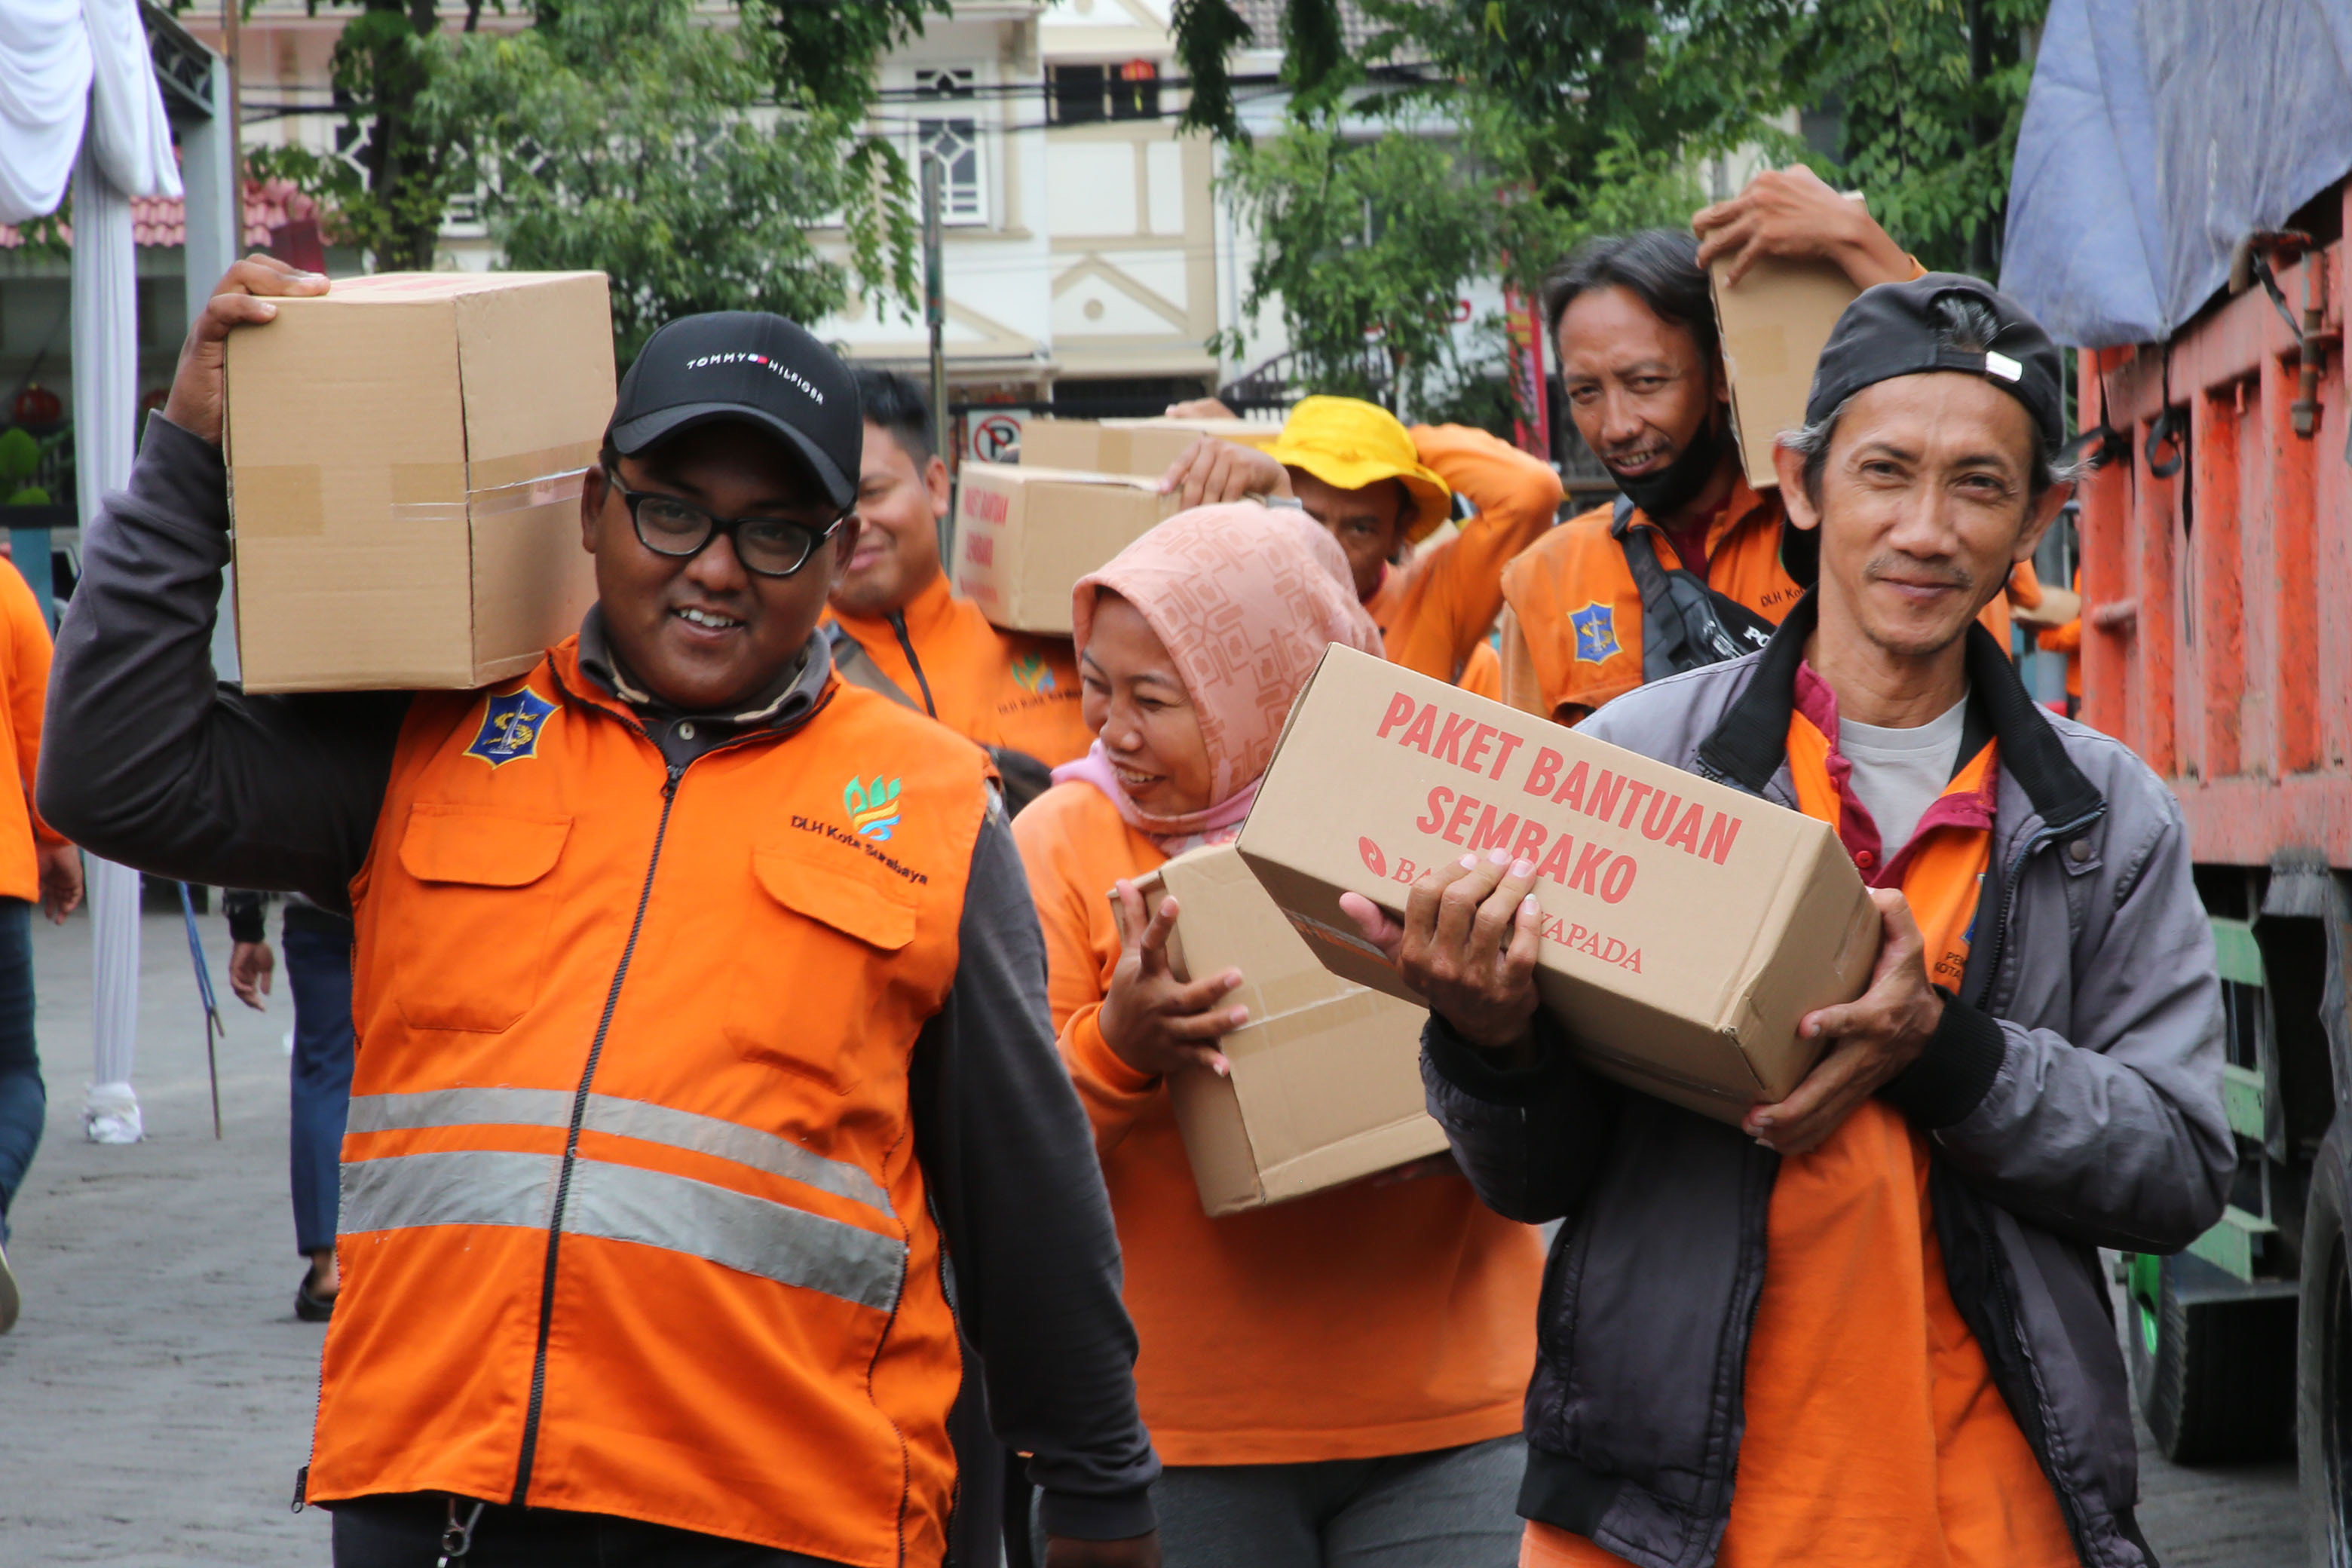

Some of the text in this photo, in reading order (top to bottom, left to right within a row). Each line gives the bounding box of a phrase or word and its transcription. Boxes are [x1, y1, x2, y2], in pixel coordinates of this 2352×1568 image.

[687, 352, 823, 406] TOMMY HILFIGER
[1784, 587, 1805, 600] Kot
[1377, 691, 1743, 865] PAKET BANTUAN
[791, 815, 824, 835] DLH
[826, 824, 862, 849] Kota
[1416, 786, 1637, 905] SEMBAKO
